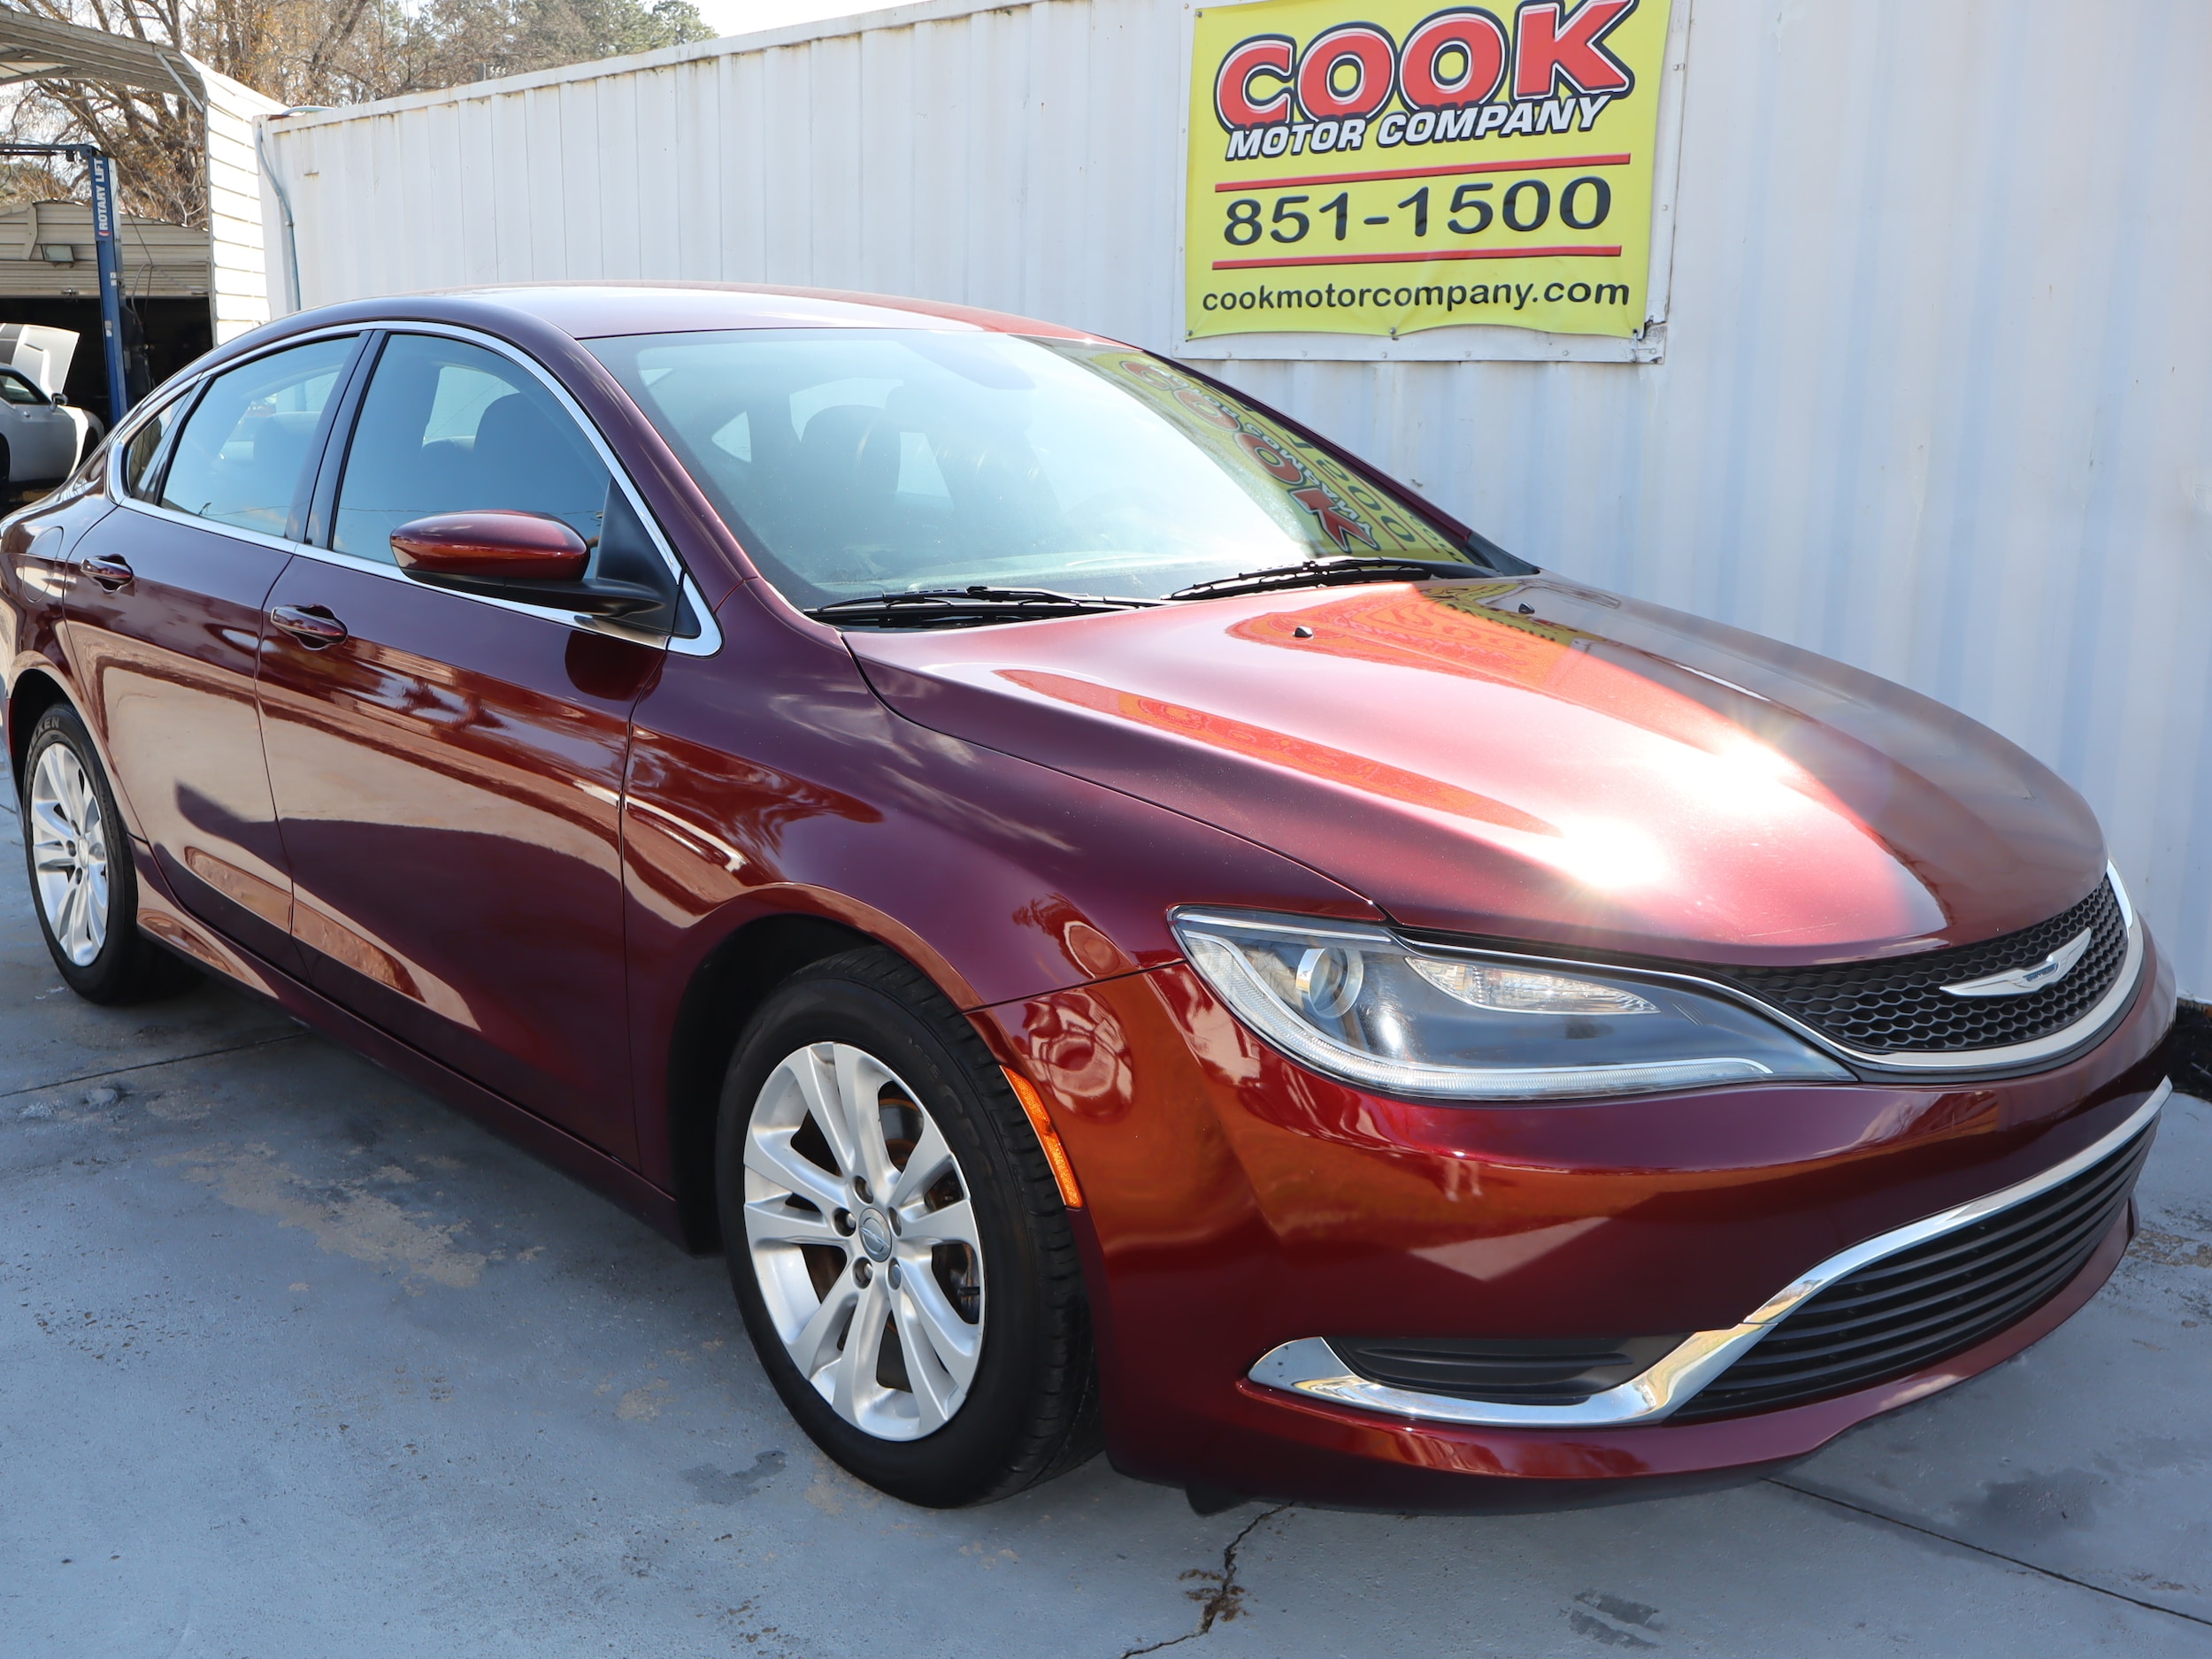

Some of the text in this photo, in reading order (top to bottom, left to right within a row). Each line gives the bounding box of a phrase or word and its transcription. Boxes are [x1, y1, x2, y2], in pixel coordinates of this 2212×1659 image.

[1215, 0, 1637, 128] COOK
[1226, 96, 1612, 159] MOTOR COMPANY
[93, 157, 108, 231] ROTARY LIFT
[1224, 176, 1611, 246] 851-1500
[1202, 281, 1630, 311] cookmotorcompany.com
